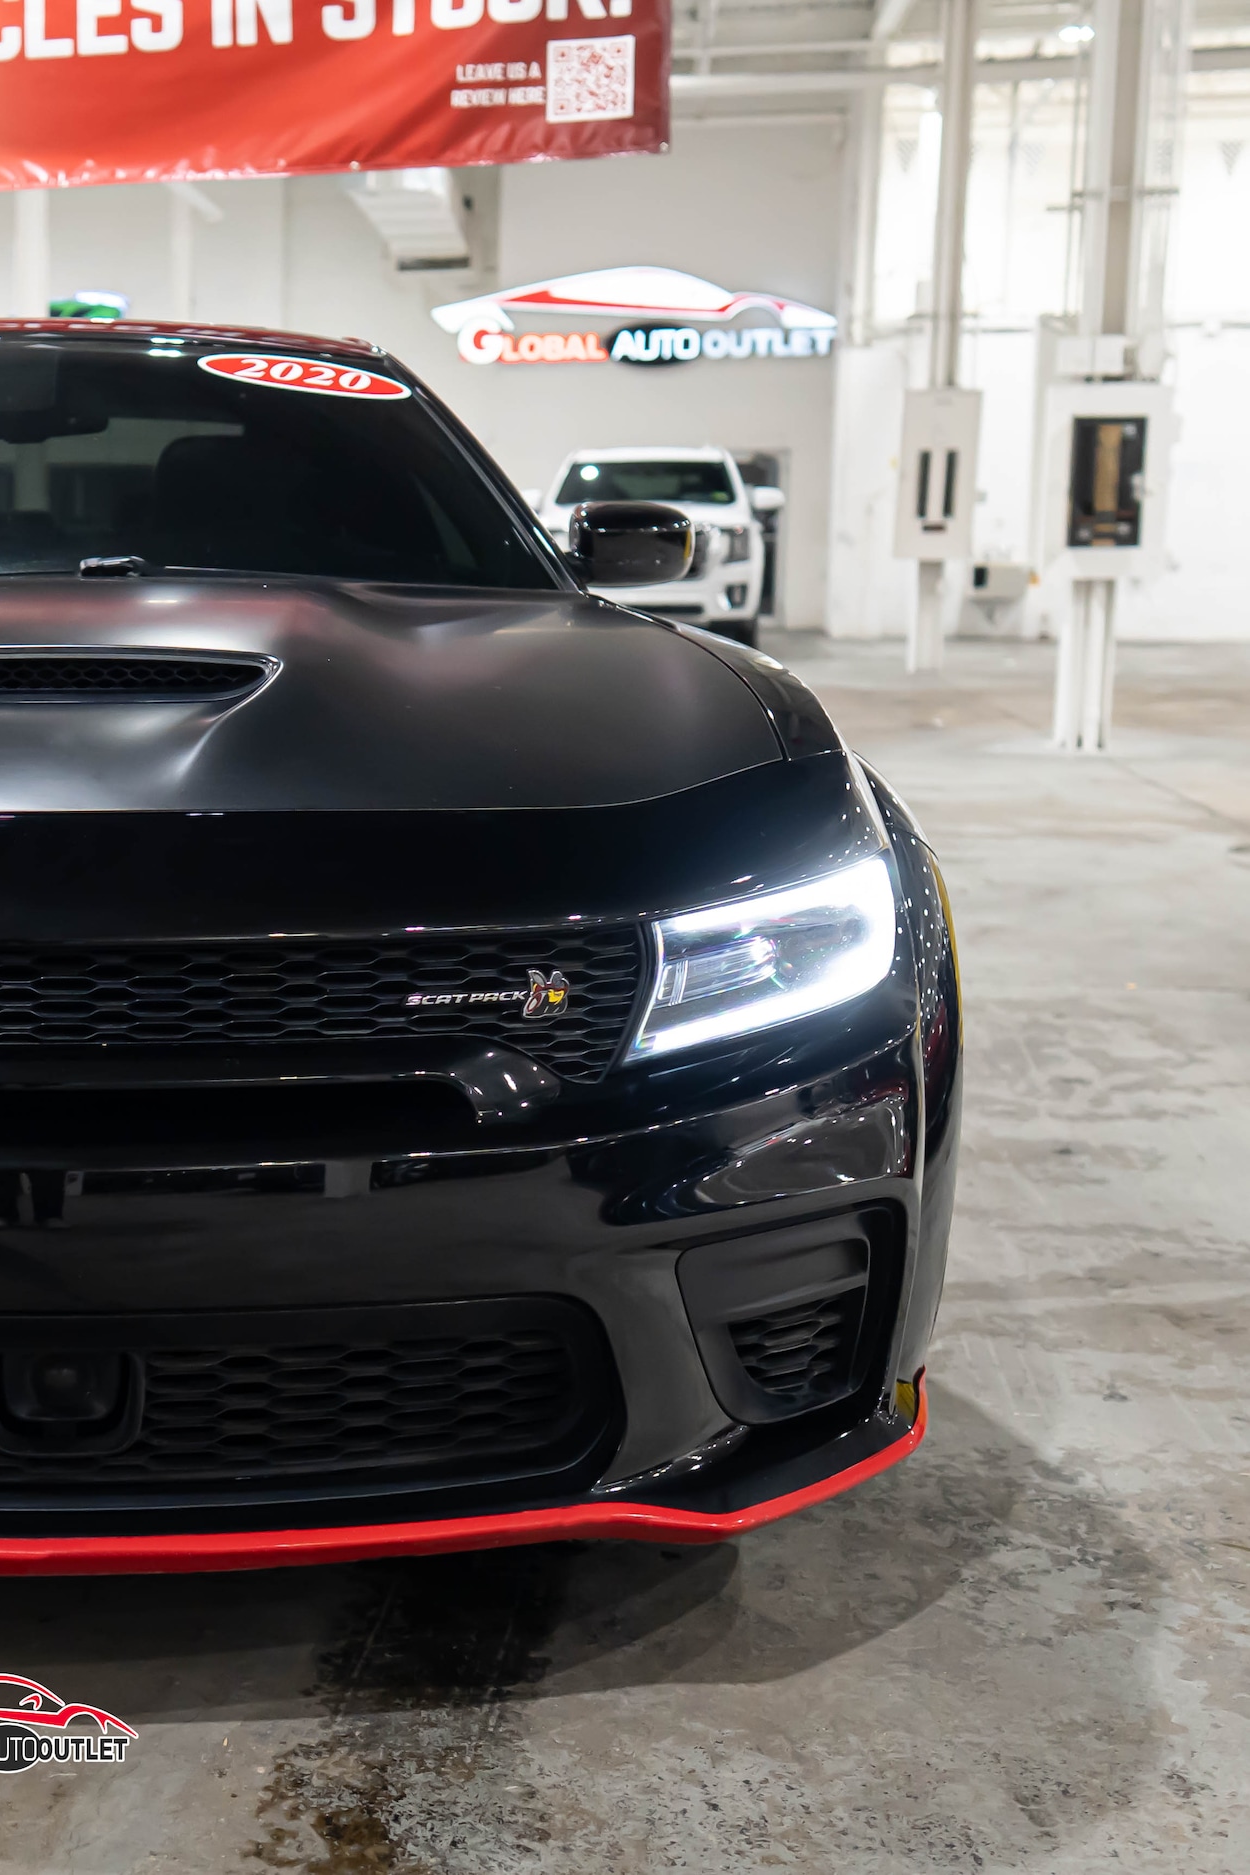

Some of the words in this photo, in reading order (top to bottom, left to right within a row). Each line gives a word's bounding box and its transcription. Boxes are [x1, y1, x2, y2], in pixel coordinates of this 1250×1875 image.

[456, 63, 506, 84] LEAVE
[528, 61, 542, 79] A
[457, 316, 608, 365] GLOBAL
[610, 328, 701, 362] AUTO
[701, 329, 836, 358] OUTLET
[234, 358, 372, 391] 2020
[405, 993, 468, 1006] SCAT
[468, 990, 527, 1003] PACK
